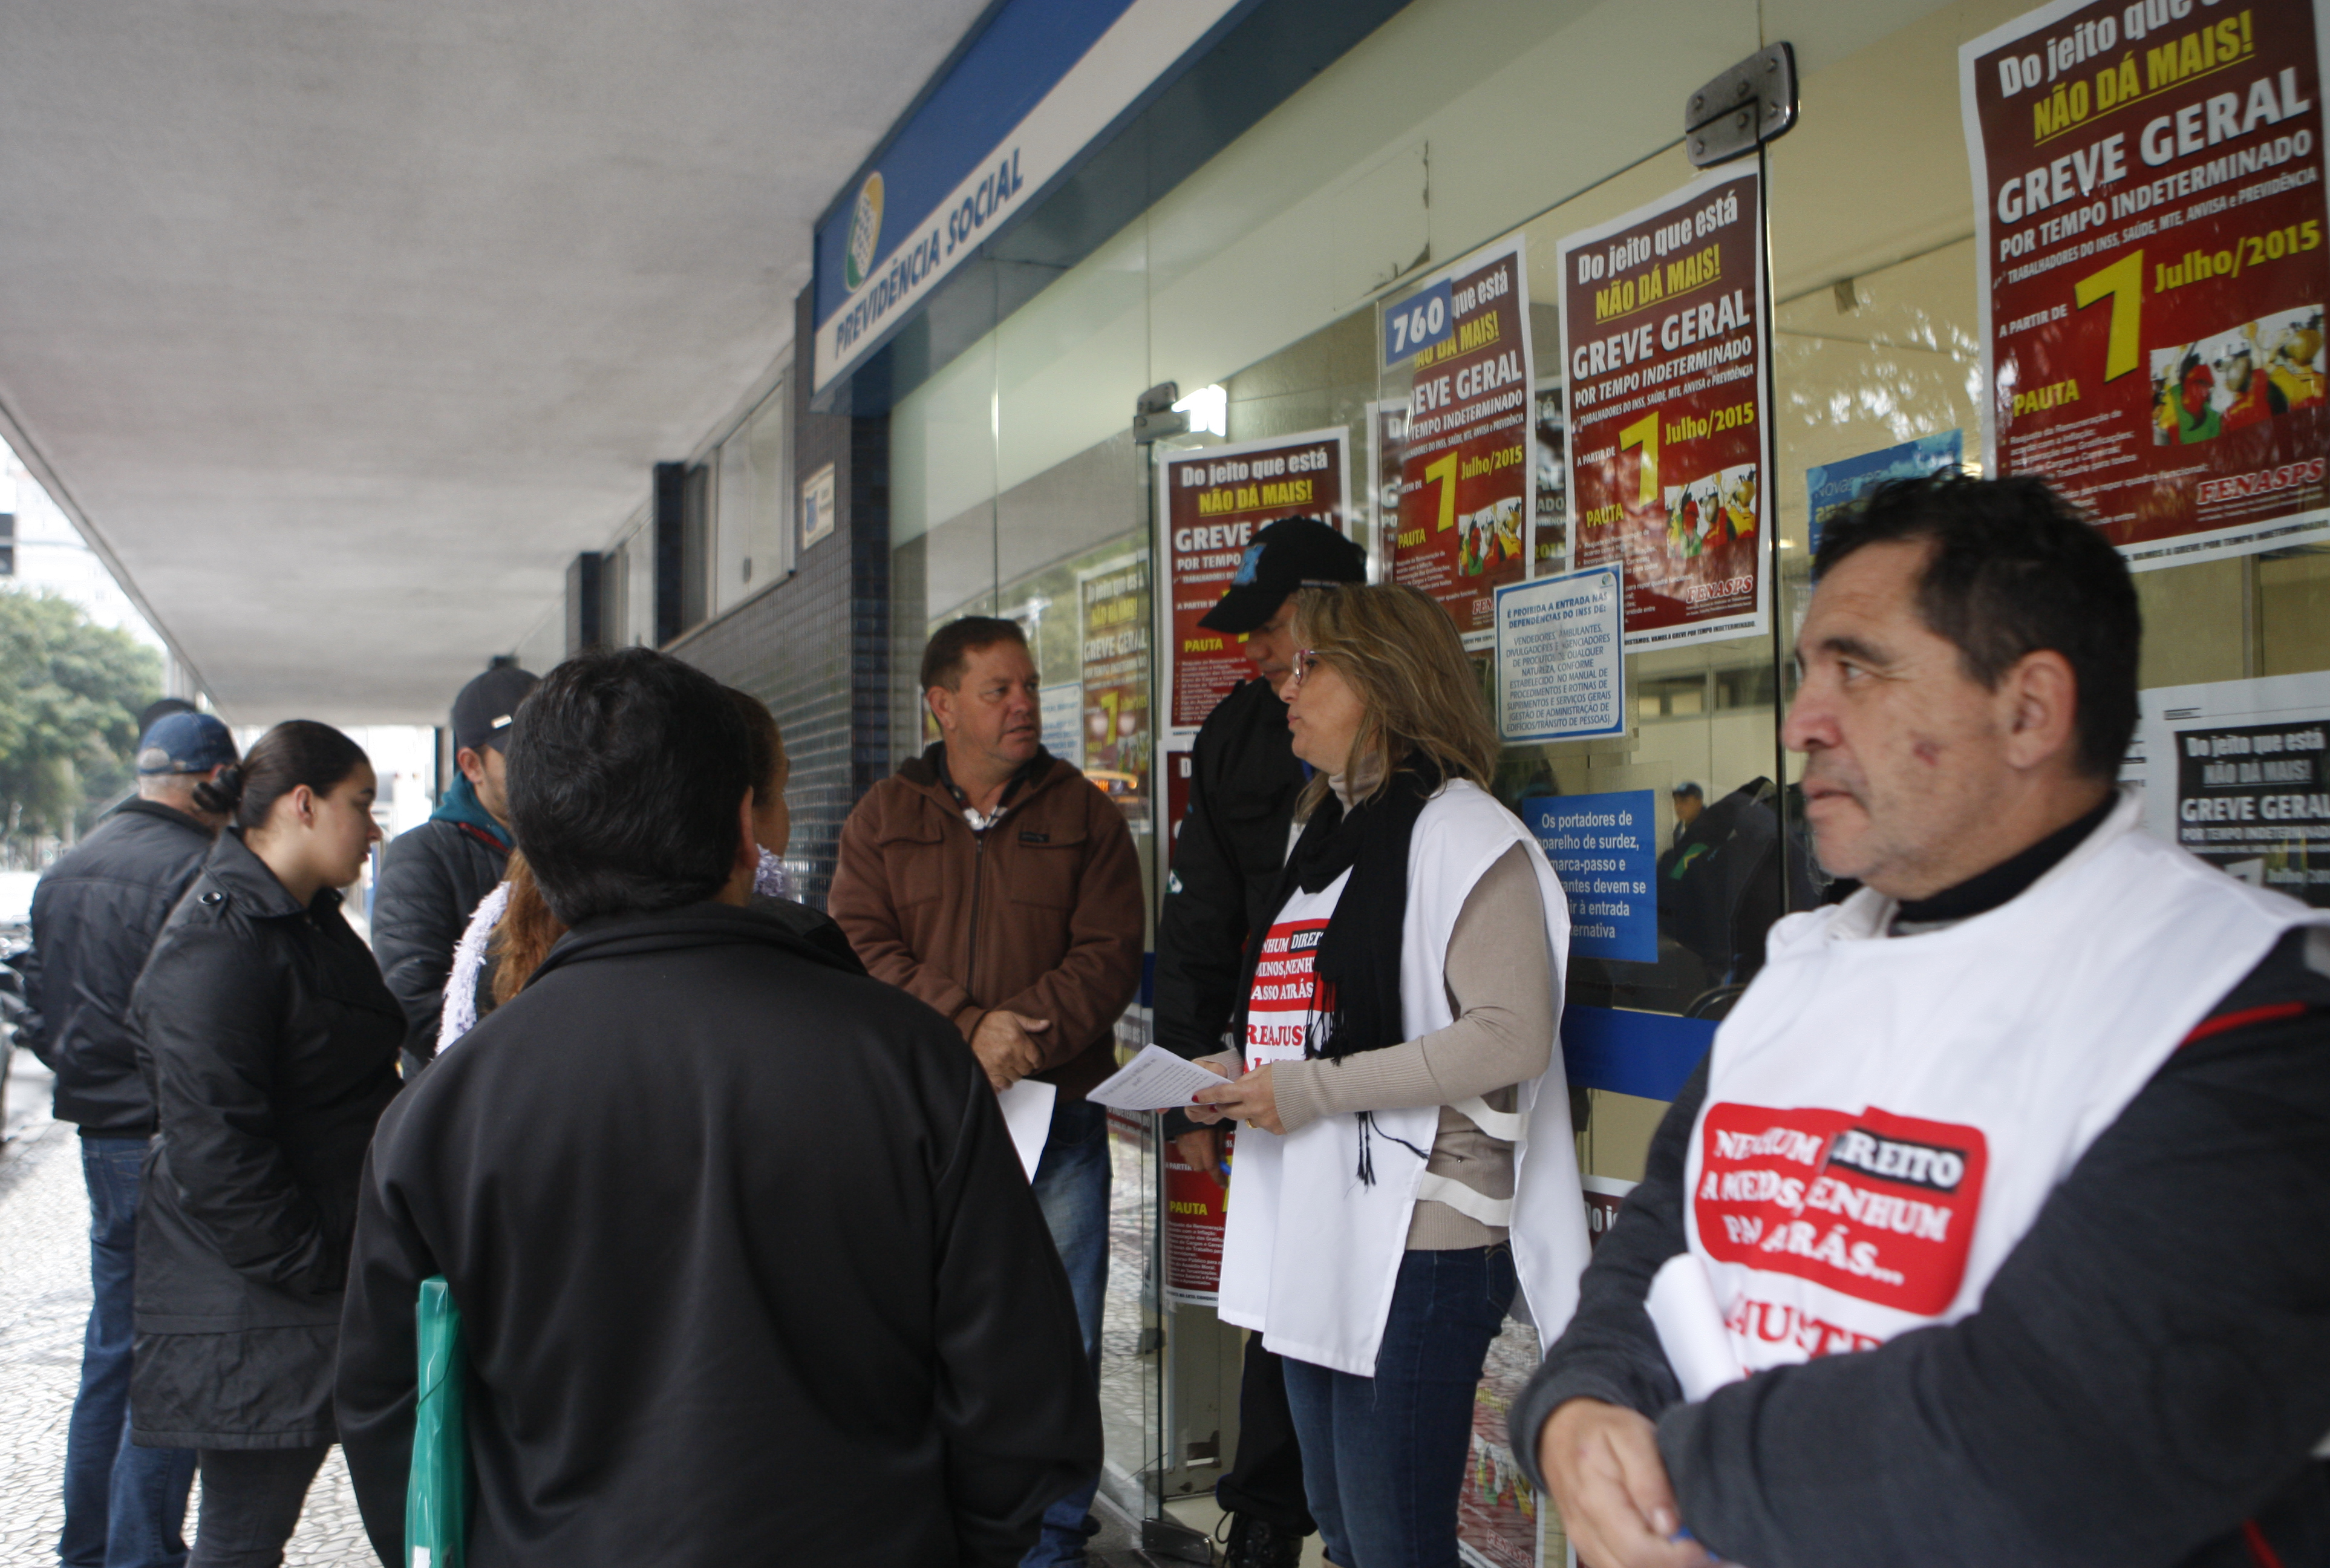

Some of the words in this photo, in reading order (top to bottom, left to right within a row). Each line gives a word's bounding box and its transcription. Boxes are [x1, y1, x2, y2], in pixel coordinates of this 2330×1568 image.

[1998, 56, 2041, 99] Do
[2047, 15, 2116, 82] jeito
[2034, 80, 2089, 141] NÃO
[2097, 50, 2141, 111] DÁ
[2146, 9, 2254, 91] MAIS!
[1998, 132, 2128, 225] GREVE
[2140, 67, 2311, 168] GERAL
[2000, 229, 2036, 263] POR
[2039, 201, 2107, 247] TEMPO
[2111, 129, 2312, 221] INDETERMINADO
[1578, 254, 1604, 285] Do
[1608, 235, 1651, 278] jeito
[1655, 217, 1692, 257] que
[1695, 189, 1738, 238] está
[2008, 247, 2079, 285] TRABALHADORES
[2080, 241, 2094, 256] DO
[2186, 195, 2227, 224] ANVISA
[2238, 166, 2319, 206] PREVIDÊNCIA
[835, 228, 941, 361] PREVIDÊNCIA
[947, 147, 1023, 256] SOCIAL
[2155, 219, 2322, 294] Julho/2015
[1453, 286, 1476, 319] que
[1478, 264, 1509, 304] está
[1596, 279, 1634, 321] NÃO
[1639, 264, 1663, 305] DÁ
[1667, 244, 1720, 295] MAIS!
[1394, 296, 1444, 354] 760
[1460, 309, 1500, 352] MAIS!
[1999, 324, 2007, 339] A
[2009, 310, 2050, 335] PARTIR
[2054, 303, 2067, 319] DE
[2074, 249, 2144, 385] 7
[1573, 323, 1653, 381] GREVE
[1661, 289, 1751, 351] GERAL
[1456, 350, 1522, 400] GERAL
[1575, 385, 1596, 409] POR
[1599, 371, 1639, 401] TEMPO
[1642, 335, 1752, 387] INDETERMINADO
[1581, 403, 1622, 427] TRABALHADORES
[1623, 402, 1631, 413] DO
[1633, 396, 1646, 410] INSS,
[1647, 389, 1667, 407] SAÚDE,
[1668, 385, 1682, 400] MTE,
[1683, 378, 1706, 395] ANVISA
[1712, 363, 1754, 386] PREVIDÊNCIA
[2012, 379, 2080, 418] PAUTA
[1411, 417, 1441, 441] TEMPO
[1443, 389, 1522, 431] INDETERMINADO
[1493, 413, 1524, 431] PREVIDÊNCIA
[1665, 402, 1754, 445] Julho/2015
[1182, 466, 1206, 487] Do
[1209, 461, 1249, 487] jeito
[1251, 457, 1285, 480] que
[1289, 447, 1328, 474] está
[1461, 445, 1523, 481] Julho/2015
[1577, 457, 1582, 468] A
[1583, 449, 1606, 465] PARTIR
[1608, 446, 1616, 457] DE
[1619, 411, 1659, 508] 7
[1199, 487, 1234, 514] NÃO
[1238, 483, 1260, 509] DÁ
[1262, 479, 1313, 506] MAIS!
[1425, 451, 1458, 534] 7
[2196, 457, 2325, 505] FENASPS
[1587, 503, 1624, 529] PAUTA
[1175, 521, 1252, 553] GREVE
[1398, 528, 1426, 549] PAUTA
[1177, 556, 1200, 572] POR
[1203, 552, 1241, 570] TEMPO
[1686, 575, 1754, 604] FENASPS
[1507, 607, 1512, 619] É
[1513, 604, 1547, 618] PROIBIDA
[1548, 603, 1554, 611] A
[1556, 595, 1590, 610] ENTRADA
[1592, 592, 1608, 603] NAS
[1509, 612, 1561, 629] DEPENDÊNCIAS
[1563, 610, 1573, 619] DO
[1576, 607, 1591, 617] INSS
[1594, 604, 1606, 613] DE:
[1184, 638, 1224, 653] PAUTA
[1506, 643, 1553, 658] DIVULGADORES
[1514, 632, 1555, 646] VENDEDORES
[1513, 658, 1521, 667] DE
[1567, 646, 1604, 659] QUALQUER
[1558, 658, 1594, 672] CONFORME
[1510, 676, 1554, 689] ESTABELECIDO
[1558, 674, 1567, 683] NO
[1569, 670, 1597, 682] MANUAL
[1599, 668, 1608, 677] DE
[1510, 685, 1561, 700] PROCEDIMENTOS
[1563, 684, 1567, 693] E
[1568, 681, 1597, 692] ROTINAS
[1599, 679, 1608, 689] DE
[1507, 697, 1549, 711] SUPRIMENTOS
[1550, 697, 1555, 706] E
[1556, 693, 1586, 705] SERVIÇOS
[1588, 691, 1611, 702] GERAIS
[1536, 709, 1544, 718] DE
[1546, 702, 1598, 717] ADMINISTRAÇÃO
[1600, 702, 1609, 712] DE
[1100, 690, 1119, 746] 7
[1507, 716, 1568, 733] EDIFÍCIOS/TRÂNSITO
[1569, 716, 1578, 726] DE
[2185, 736, 2210, 757] Do
[2211, 734, 2251, 758] jeito
[2253, 734, 2283, 756] que
[2285, 727, 2326, 751] está
[2203, 760, 2237, 785] NÃO
[2239, 759, 2262, 784] DÁ
[2262, 759, 2312, 782] MAIS!
[1542, 813, 1555, 828] Os
[1559, 811, 1615, 831] portadores
[1619, 810, 1632, 826] de
[2181, 796, 2256, 822] GREVE
[2260, 794, 2330, 820] GERAL
[1583, 834, 1596, 849] de
[1599, 833, 1639, 851] surdez,
[1550, 858, 1616, 875] marca-passo
[1619, 858, 1626, 871] e
[1594, 878, 1630, 893] devem
[1633, 881, 1646, 894] se
[1580, 899, 1586, 915] à
[1588, 901, 1630, 916] entrada
[1262, 938, 1290, 954] NHUM
[1251, 985, 1278, 1000] ASSO
[1246, 1024, 1307, 1046] REAJUS
[1169, 1200, 1208, 1215] PAUTA
